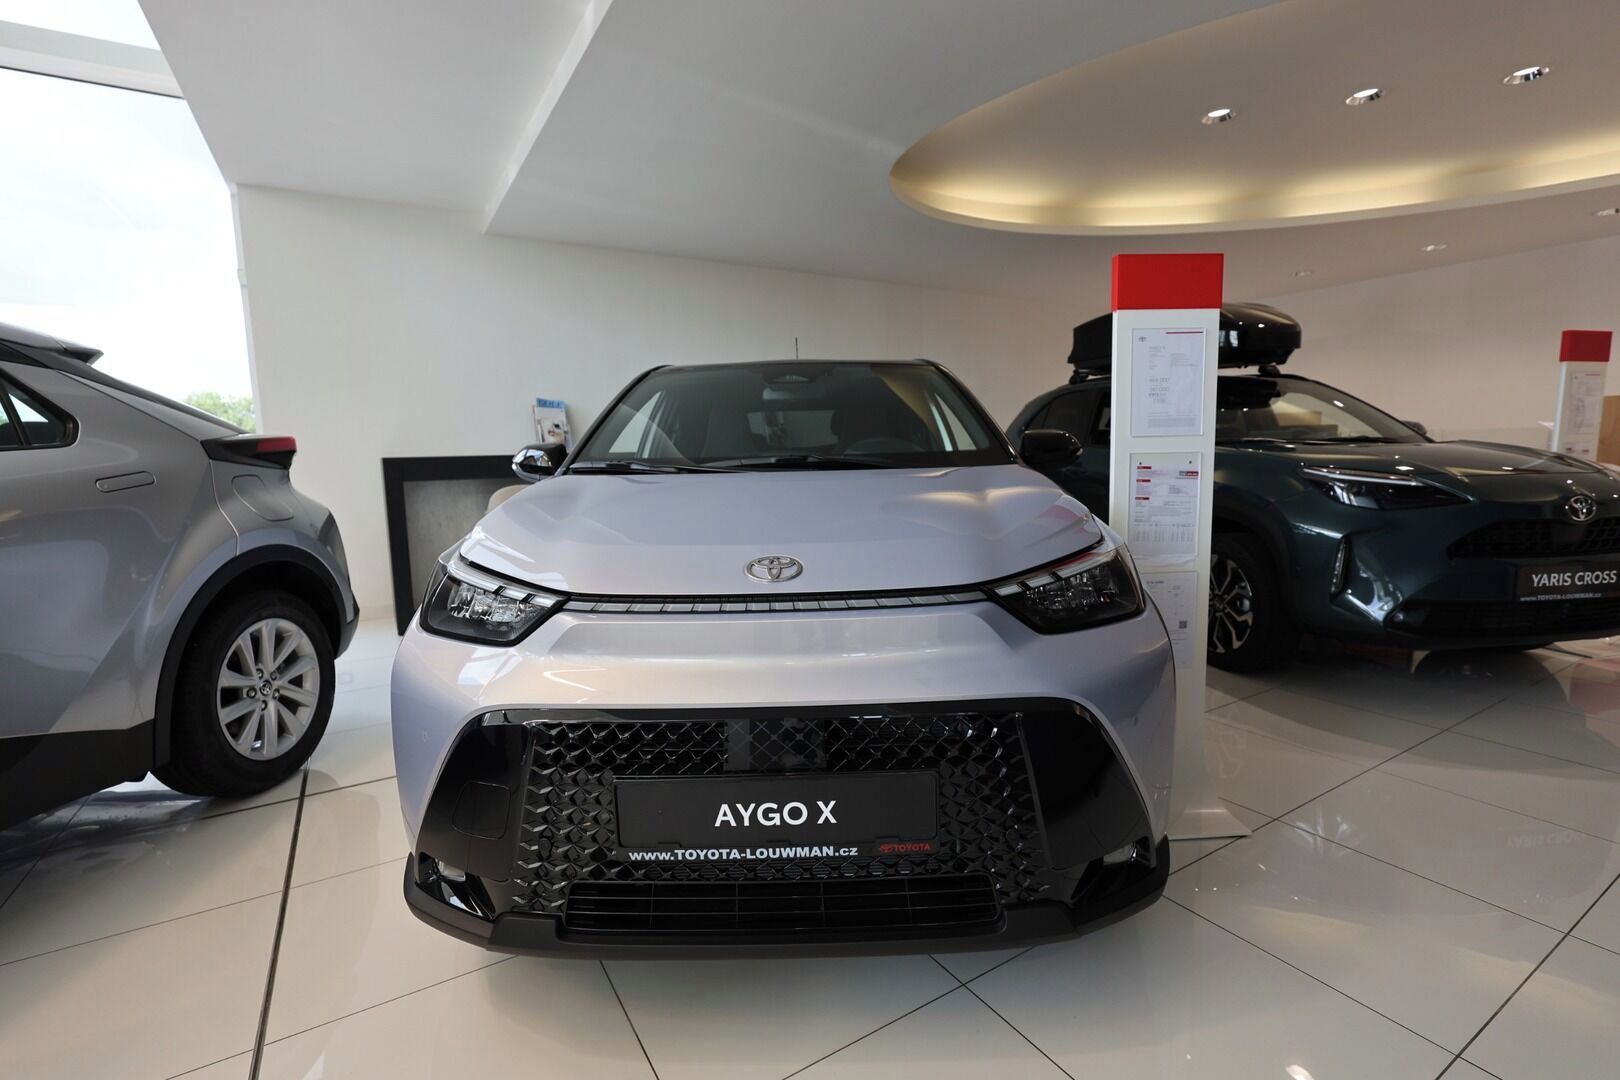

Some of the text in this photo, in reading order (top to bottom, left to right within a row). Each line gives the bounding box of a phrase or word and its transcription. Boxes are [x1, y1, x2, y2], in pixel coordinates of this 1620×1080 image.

[1531, 570, 1618, 587] YARIS CROSS
[714, 799, 837, 827] AYGO X
[628, 846, 858, 862] www.TOYOTA-LOUWMAN.cz
[894, 843, 931, 853] TOYOTA
